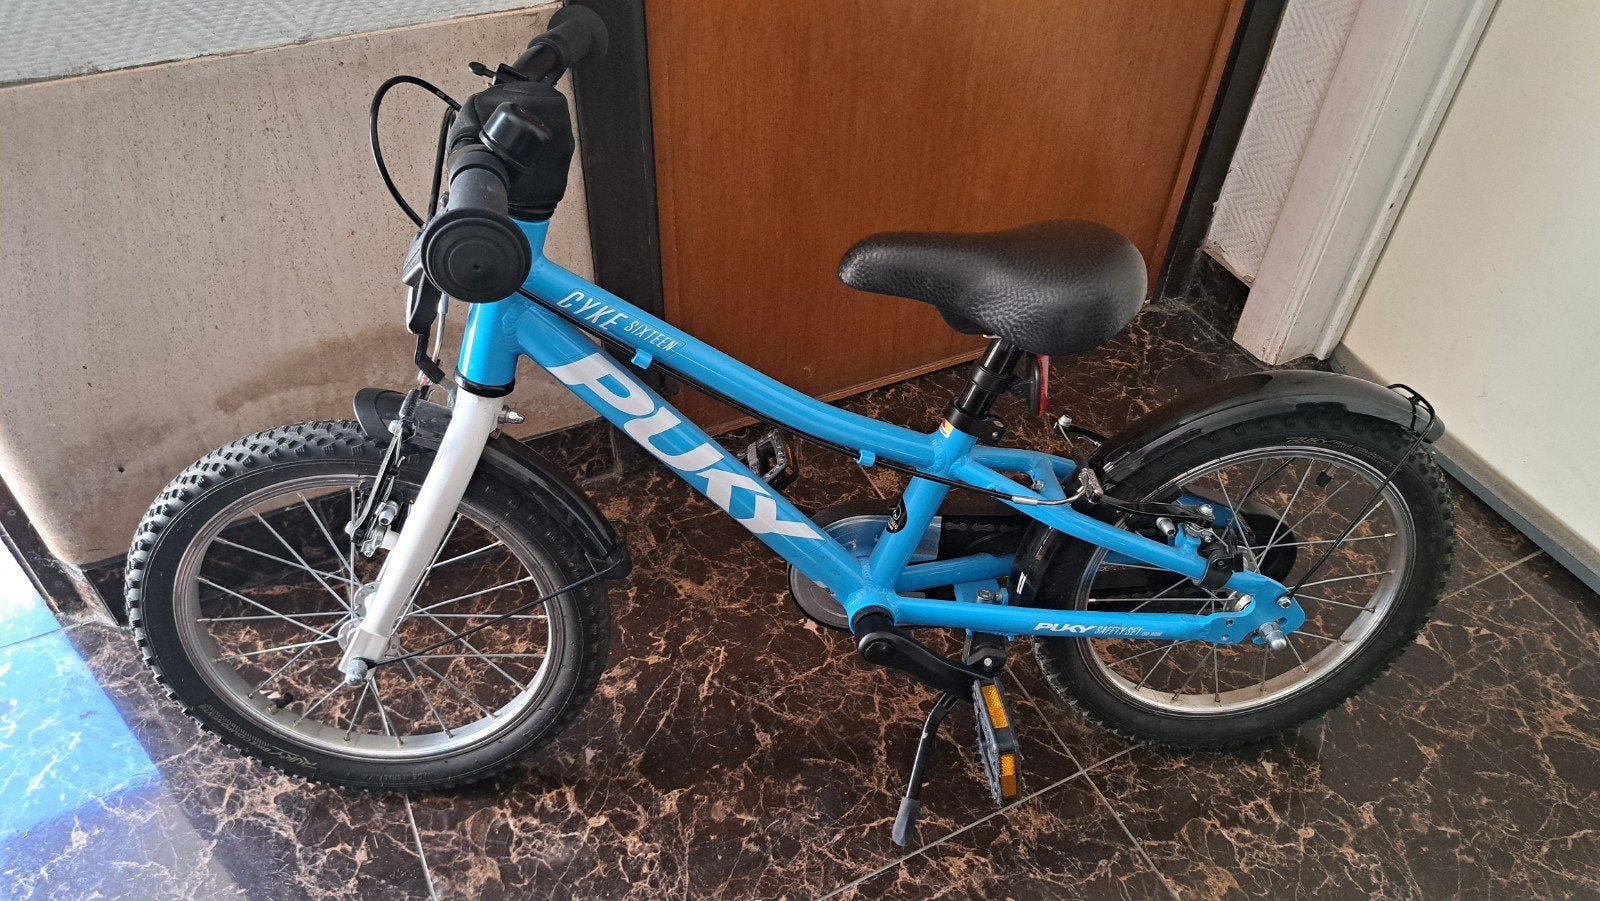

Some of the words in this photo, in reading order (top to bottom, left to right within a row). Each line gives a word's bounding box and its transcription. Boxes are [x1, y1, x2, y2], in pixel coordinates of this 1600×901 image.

[556, 291, 629, 330] CYKE
[624, 320, 679, 352] SIXTEEN
[545, 352, 826, 541] PUKY
[1034, 622, 1097, 634] PUKY
